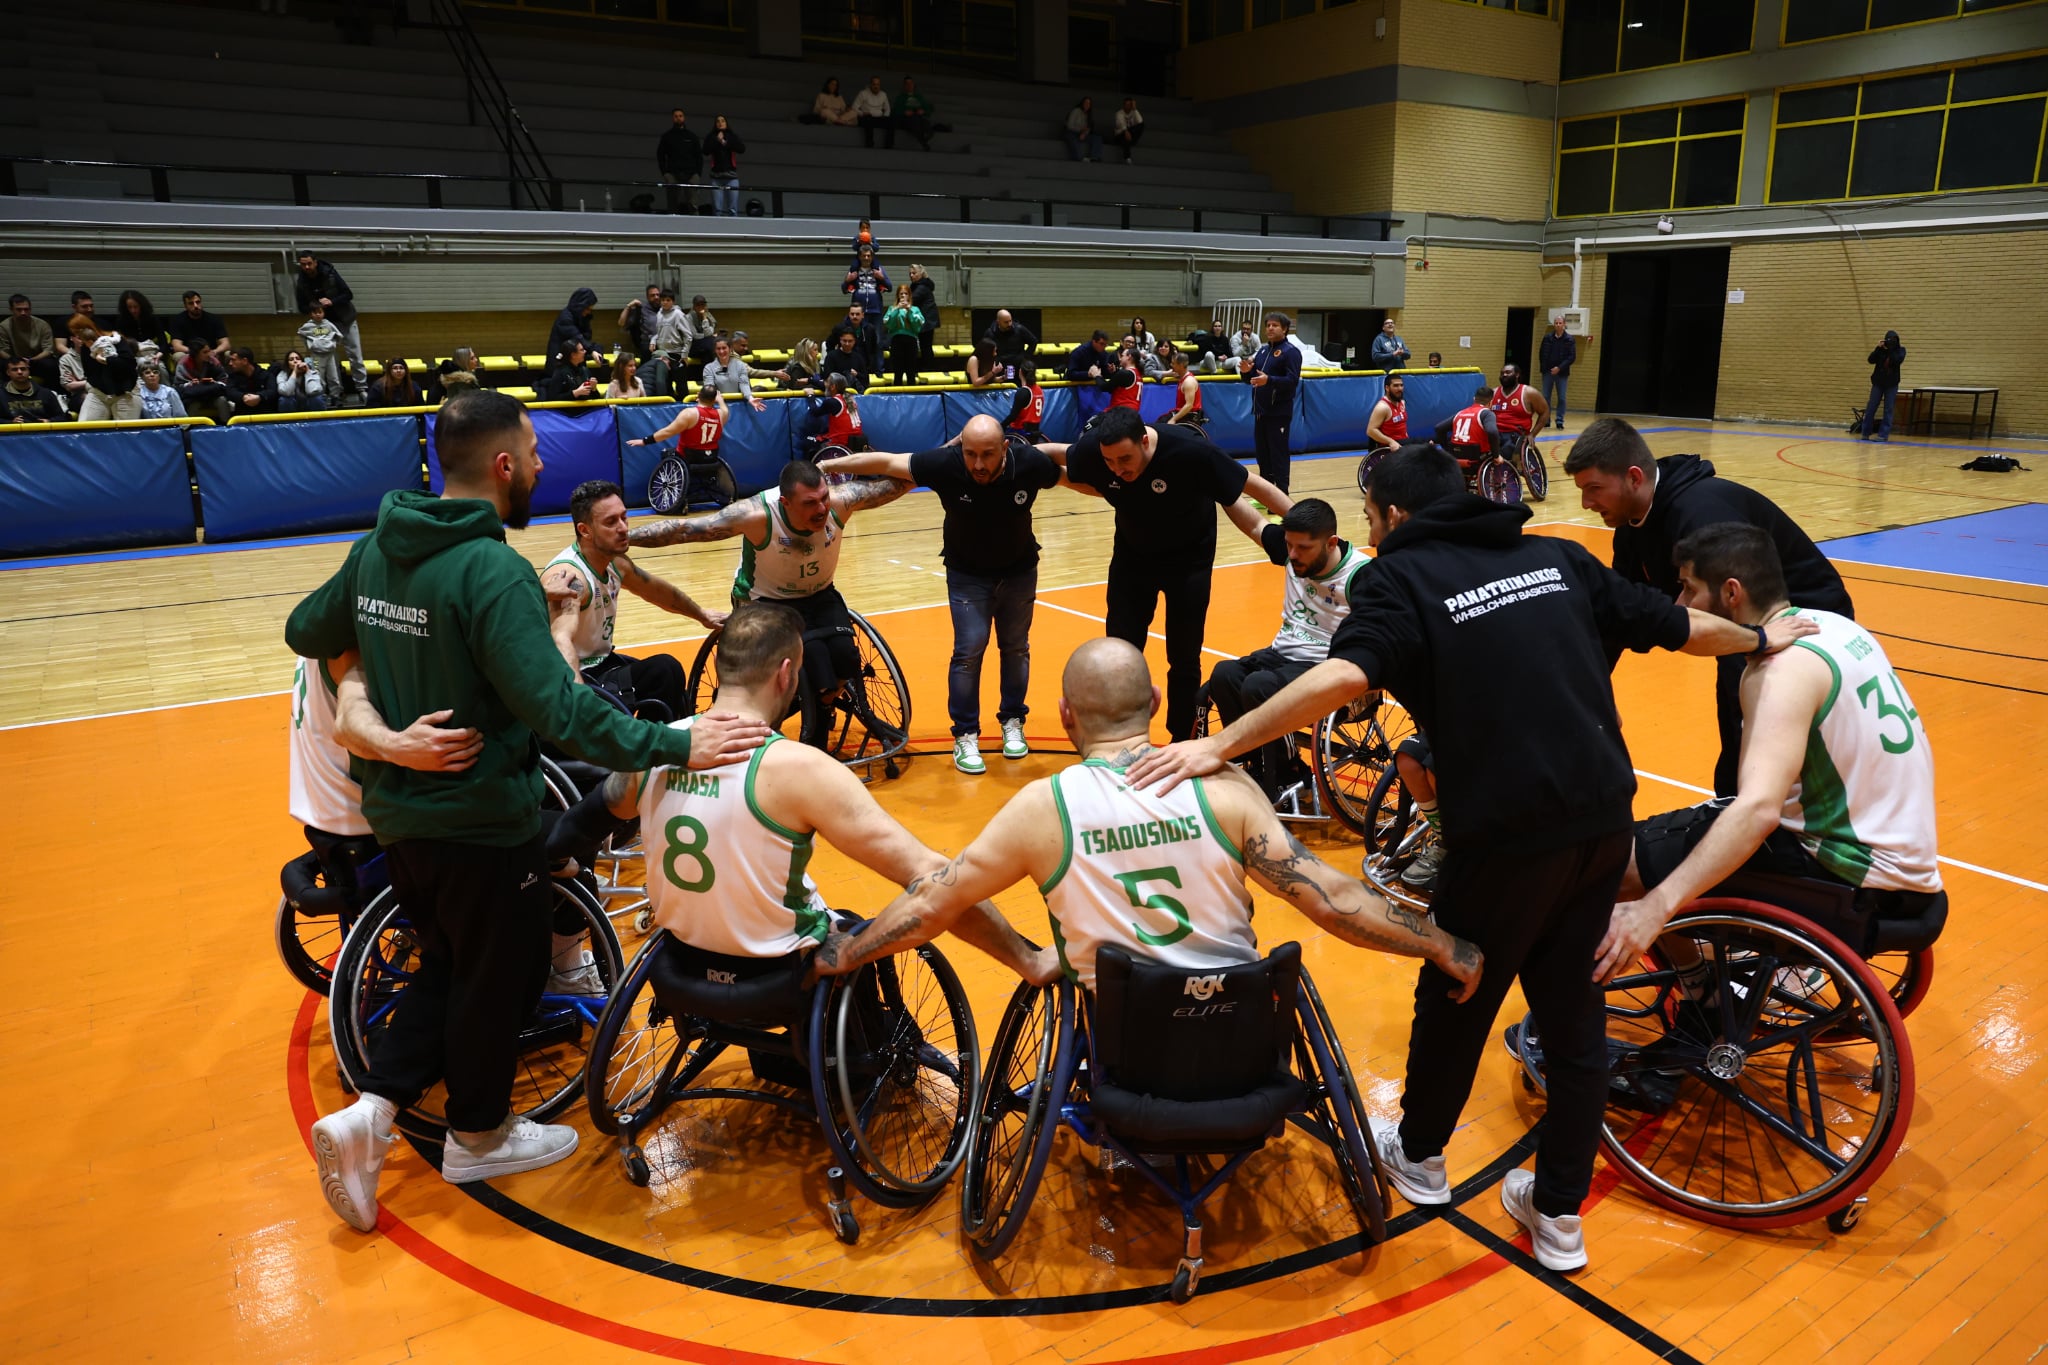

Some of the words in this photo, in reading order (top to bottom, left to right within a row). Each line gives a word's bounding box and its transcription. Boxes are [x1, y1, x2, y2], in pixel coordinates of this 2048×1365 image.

[1036, 398, 1042, 417] 9
[700, 422, 718, 444] 17
[1453, 418, 1471, 442] 14
[800, 560, 820, 578] 13
[1444, 567, 1561, 612] PANATHINAIKOS
[1451, 594, 1519, 624] WHEELCHAIR
[1519, 582, 1569, 601] BASKETBALL
[1080, 815, 1201, 855] TSAOUSIDIS
[663, 815, 715, 893] 8
[1113, 866, 1193, 946] 5
[1173, 1001, 1238, 1017] ELITE
